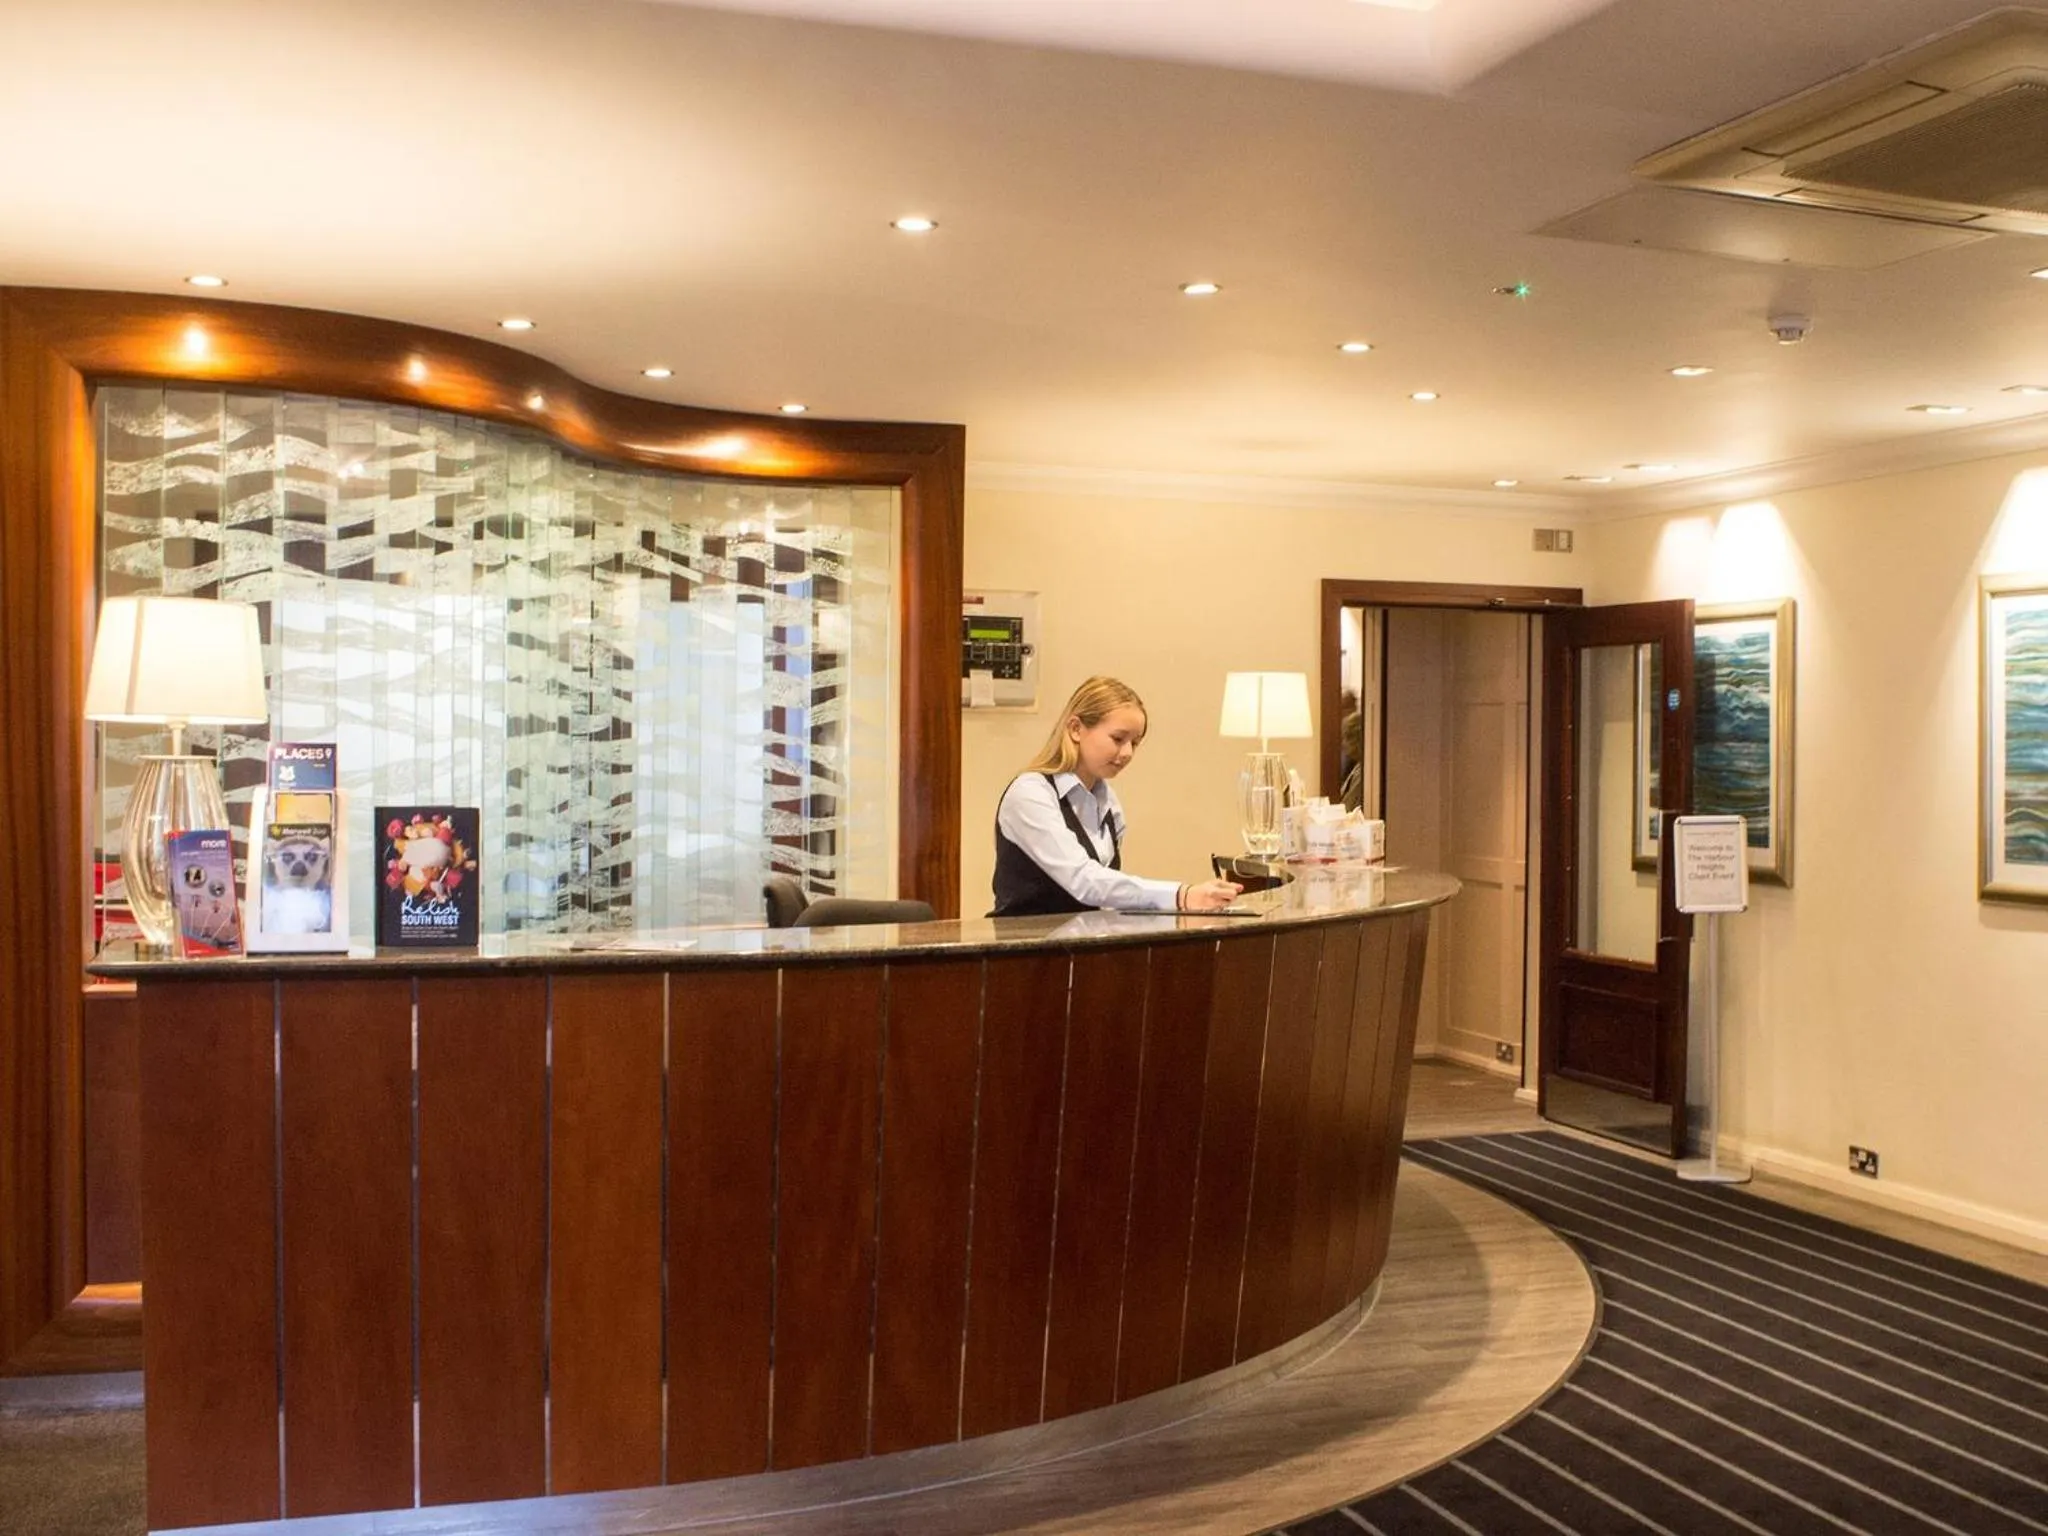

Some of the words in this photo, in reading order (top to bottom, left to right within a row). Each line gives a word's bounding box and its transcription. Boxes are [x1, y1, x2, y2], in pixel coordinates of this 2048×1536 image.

[275, 747, 324, 760] PLACES
[201, 840, 227, 849] more
[401, 914, 432, 926] SOUTH
[433, 914, 459, 926] WEST
